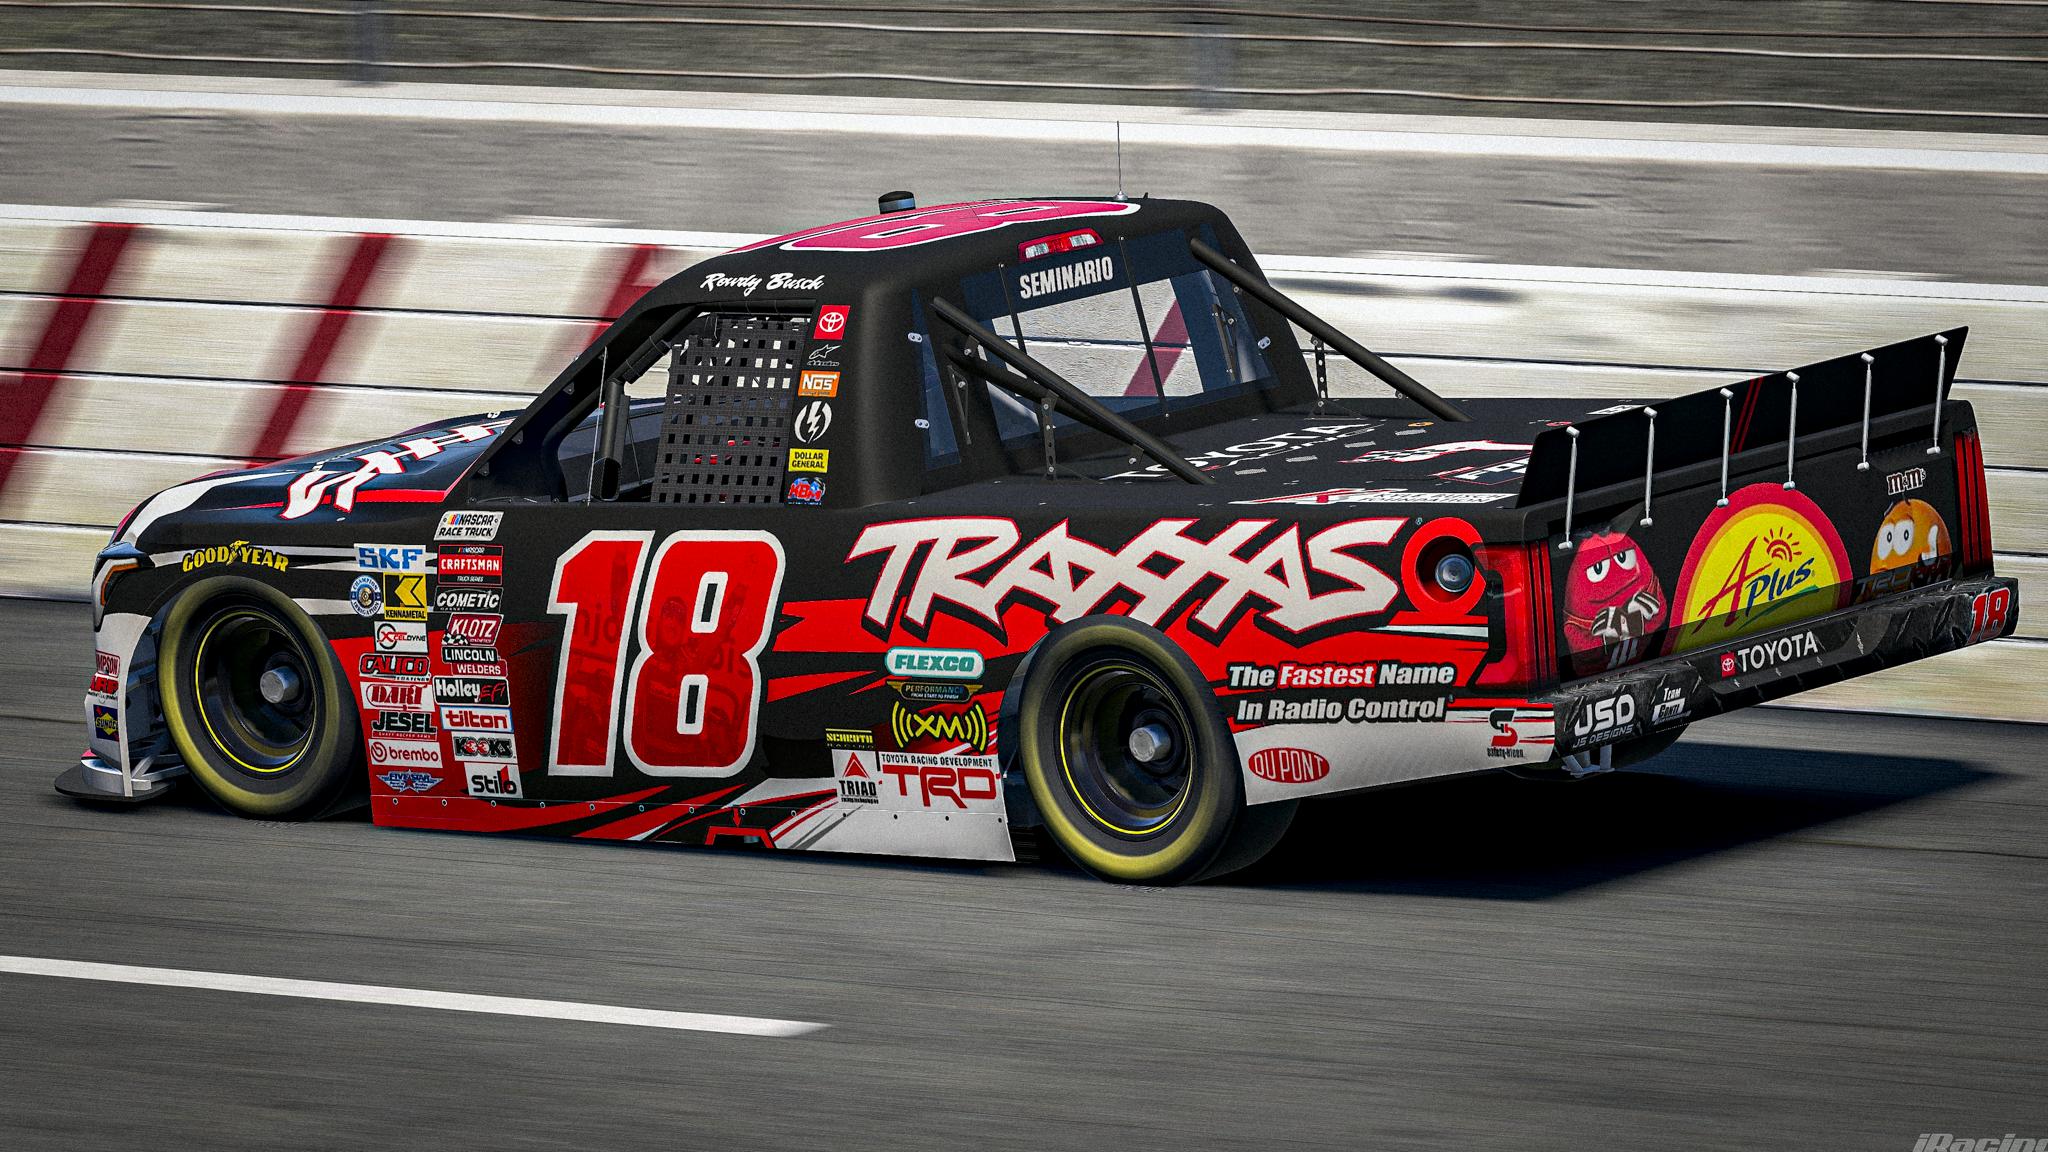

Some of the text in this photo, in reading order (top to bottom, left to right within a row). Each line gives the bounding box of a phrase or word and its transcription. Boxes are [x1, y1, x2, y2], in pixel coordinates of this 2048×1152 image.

[699, 272, 825, 297] Rowdy Busch
[1019, 256, 1114, 299] SEMINARIO
[791, 460, 825, 469] GENERAL
[794, 452, 824, 461] DOLLAR
[459, 514, 494, 526] NASCAR
[438, 527, 493, 537] RACE TRUCK
[358, 547, 423, 569] SKF
[441, 558, 500, 571] CRAFTSMAN
[844, 516, 1409, 642] TRAXXAS
[436, 589, 500, 608] COMETIC
[385, 609, 426, 619] KENNAMETAL
[1966, 587, 2011, 645] 18
[451, 618, 497, 638] KLOTZ
[444, 649, 495, 662] LINCOLN
[547, 530, 786, 777] 18
[1738, 631, 1819, 673] TOYOTA
[361, 655, 429, 675] CALICO
[457, 664, 501, 675] WELDERS
[894, 654, 976, 672] FLEXCO
[1228, 663, 1455, 687] The Fastest Name
[370, 683, 428, 705] DART
[435, 678, 506, 703] Holley EFI
[905, 684, 965, 694] PERFORMANCE
[1237, 696, 1445, 721] In Radio Control
[1574, 694, 1634, 737] JSD
[372, 711, 437, 733] JESEL
[445, 710, 508, 728] tilton
[914, 714, 965, 740] XM
[1572, 724, 1634, 748] JS DESIGNS
[389, 747, 439, 762] brembo
[454, 736, 513, 758] KOOKS
[881, 754, 993, 768] TOYOTA RACING DEVELOPMENT
[410, 773, 430, 782] STAR
[839, 779, 877, 796] TRIAD
[882, 764, 997, 809] TRD
